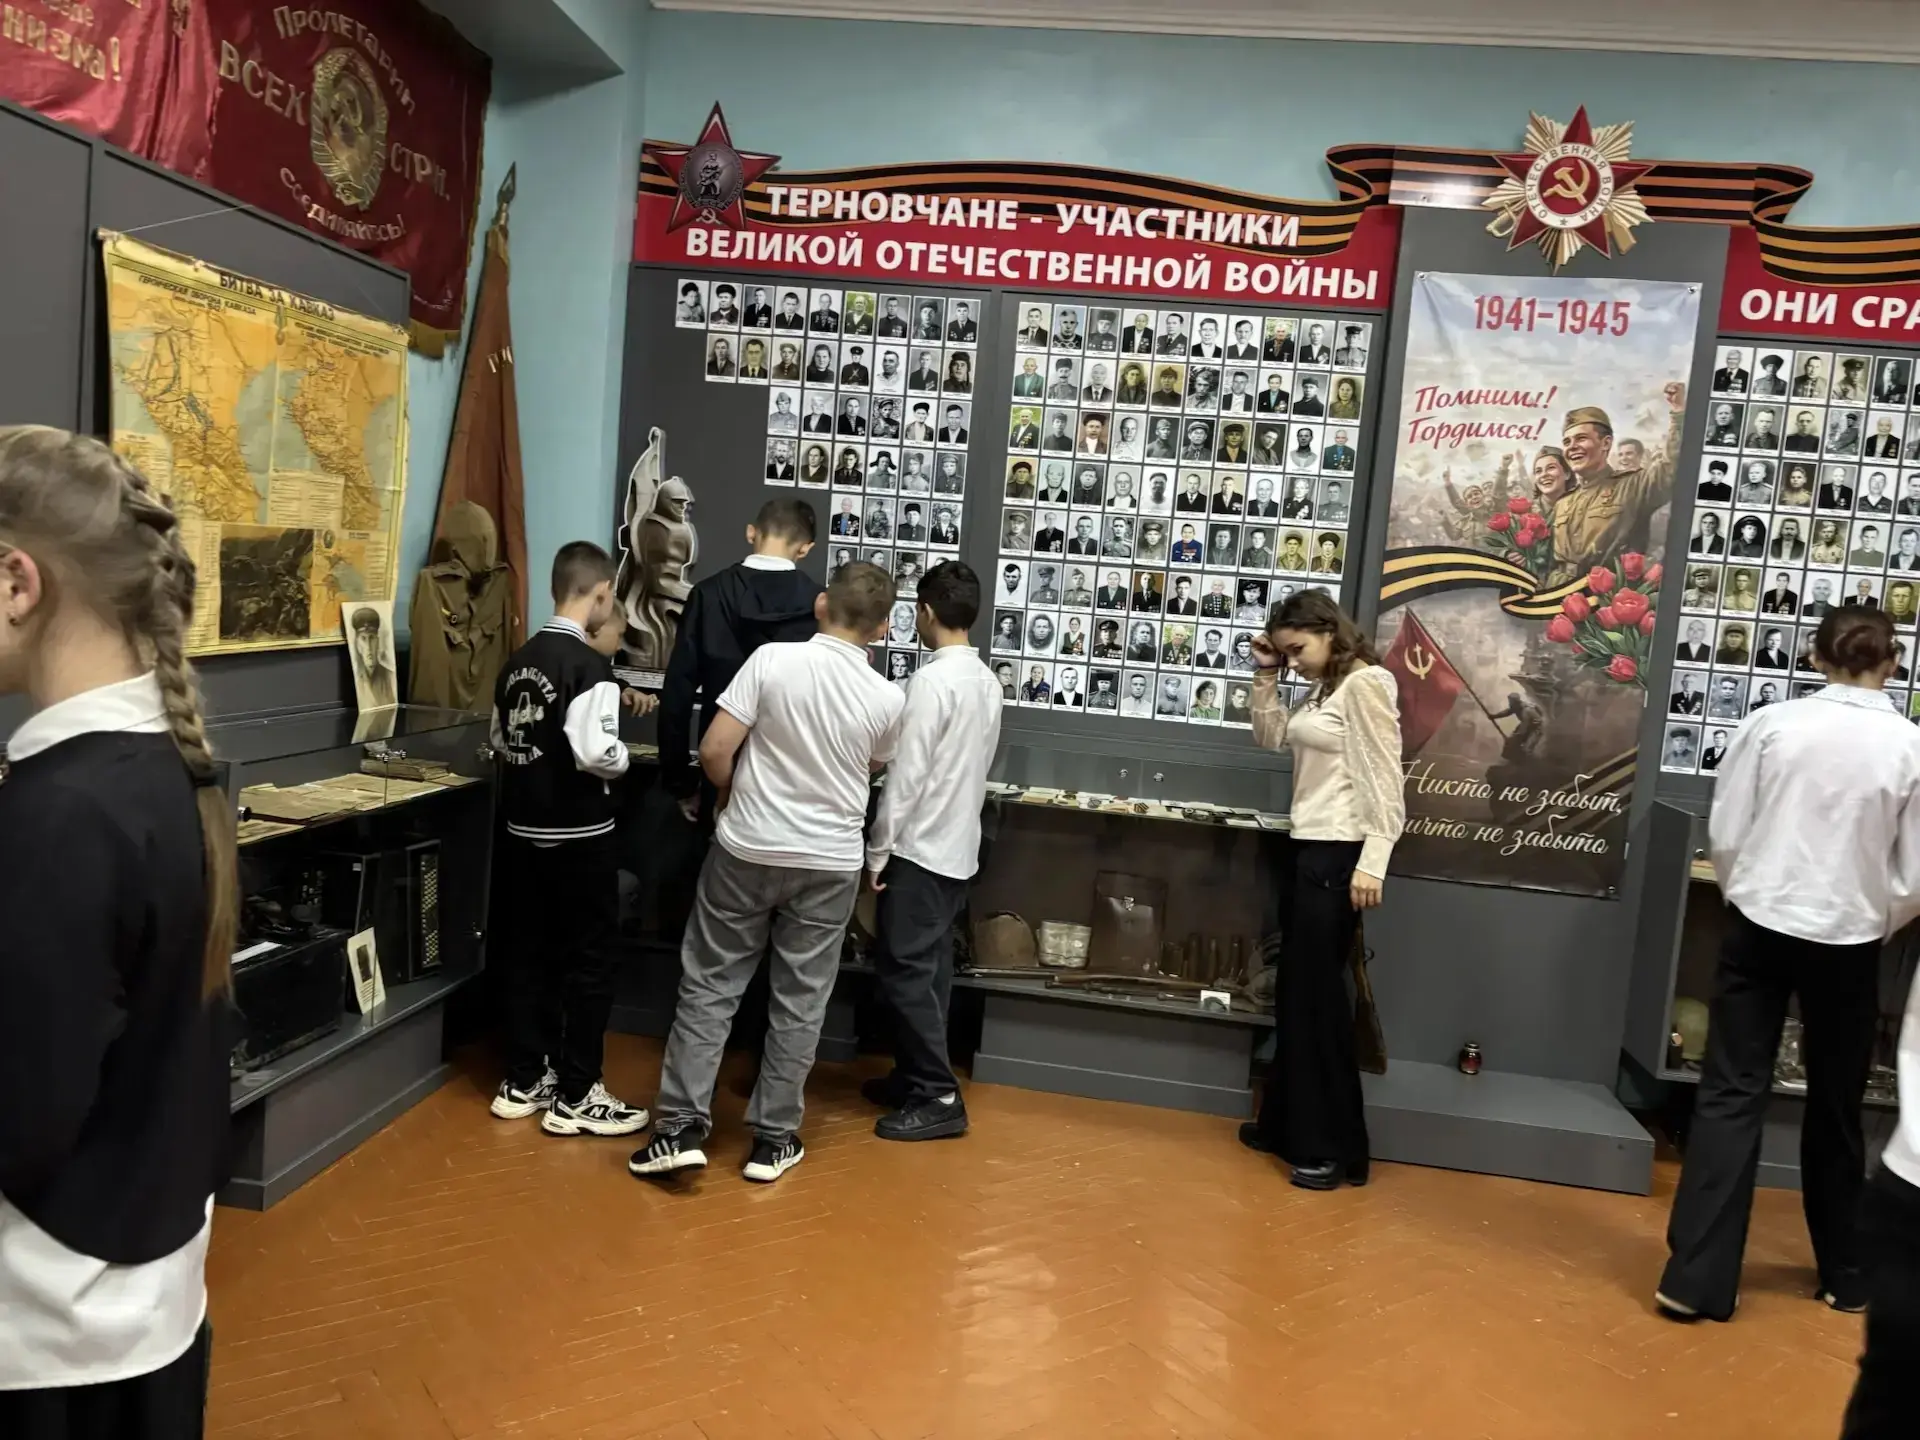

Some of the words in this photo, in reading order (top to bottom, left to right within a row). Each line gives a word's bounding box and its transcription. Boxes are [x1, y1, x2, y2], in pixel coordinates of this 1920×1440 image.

[218, 39, 306, 126] ВСЕХ
[1527, 145, 1607, 219] ОТЕЧЕСТВЕННАЯ
[765, 185, 1018, 230] ТЕРНОВЧАНЕ
[1058, 203, 1300, 247] УЧАСТНИКИ
[686, 228, 863, 268] ВЕЛИКОЙ
[876, 242, 1211, 292] ОТЕЧЕСТВЕННОЙ
[1229, 256, 1378, 300] ВОЙНЫ
[219, 273, 263, 299] БИТВА
[267, 288, 285, 304] ЗА
[288, 294, 336, 321] КАВКАЗ
[1473, 294, 1631, 337] 1941-1945
[1740, 288, 1838, 325] ОНИ
[1408, 416, 1547, 449] Гордимся!
[1400, 759, 1495, 800] Никто
[1499, 786, 1530, 803] не
[1525, 774, 1622, 816] забыт,
[1402, 816, 1470, 840] ичто
[1473, 824, 1505, 843] не
[1500, 813, 1610, 856] забыто
